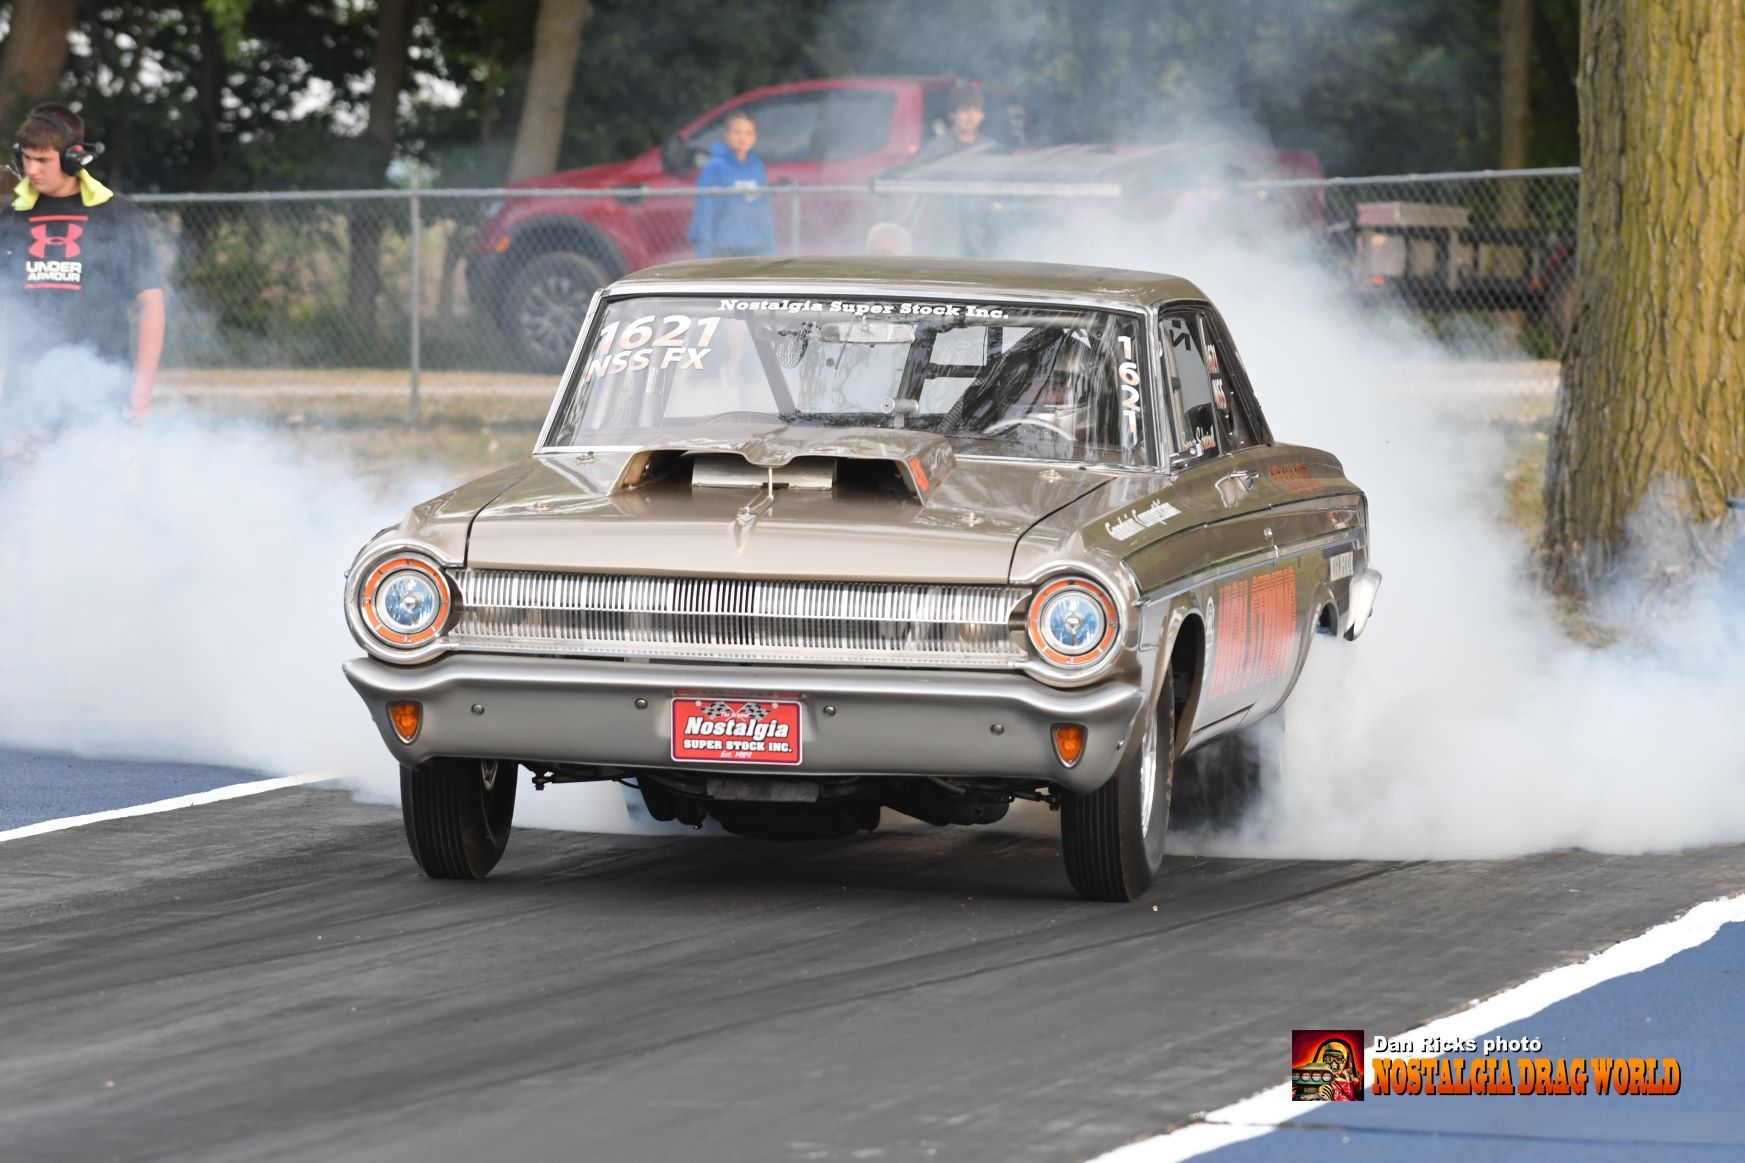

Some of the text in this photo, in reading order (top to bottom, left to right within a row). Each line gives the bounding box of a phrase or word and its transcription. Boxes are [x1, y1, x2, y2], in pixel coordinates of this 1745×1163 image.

[26, 260, 82, 273] UNDER
[27, 272, 80, 282] ARMOUR
[718, 299, 1009, 319] Nostalgia Super Stock Inc.
[600, 314, 721, 356] 1621
[585, 347, 712, 381] NSS FX
[1117, 335, 1141, 434] 1621
[684, 716, 789, 741] Nostalgia
[683, 739, 793, 753] SUPER STOCK INC.
